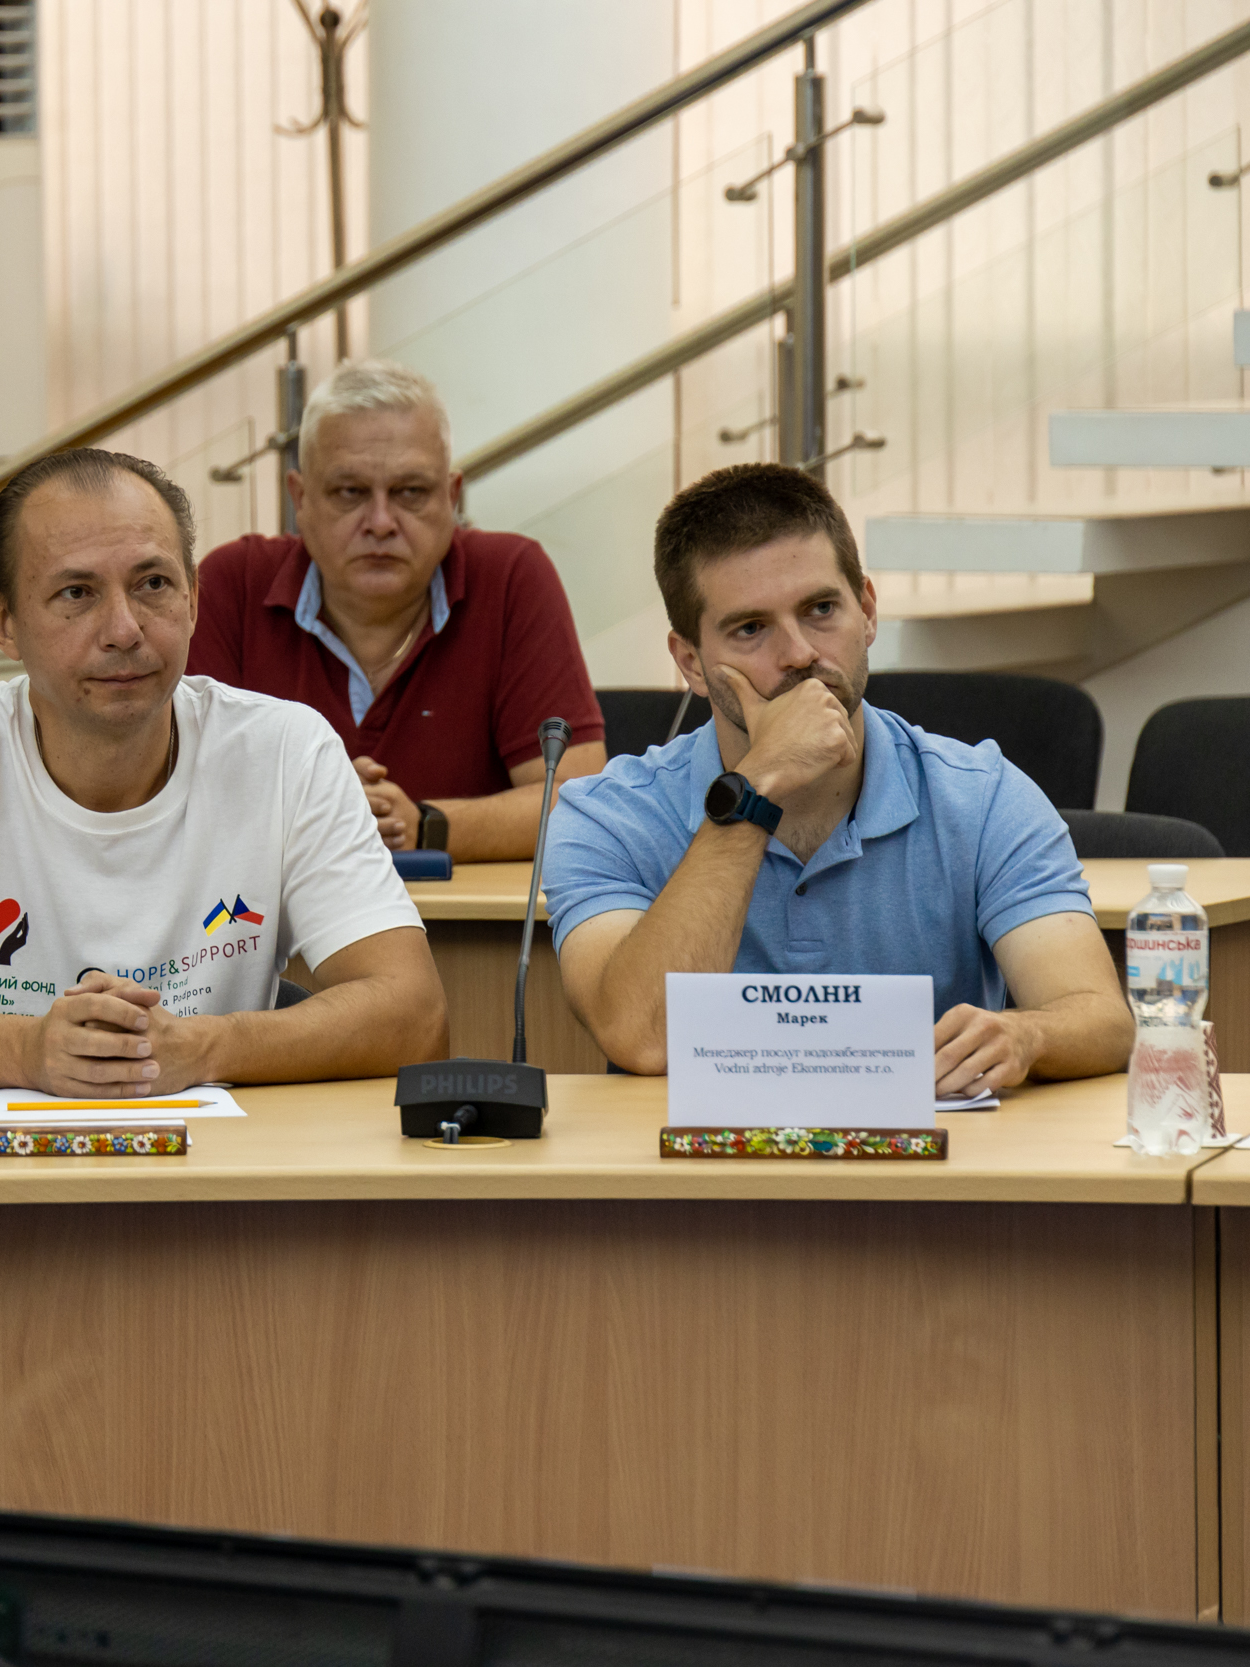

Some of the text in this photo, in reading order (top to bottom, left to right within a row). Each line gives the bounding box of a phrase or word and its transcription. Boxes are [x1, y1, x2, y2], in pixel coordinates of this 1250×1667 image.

[21, 980, 56, 996] ФОНД
[167, 976, 189, 991] fond
[173, 986, 212, 1004] podpora
[741, 985, 862, 1004] СМОЛНИ
[776, 1012, 829, 1027] Марек
[693, 1047, 758, 1060] Менеджер
[761, 1049, 801, 1061] послуг
[752, 1063, 788, 1076] zdroje
[791, 1063, 862, 1074] Ekomonitor
[865, 1065, 894, 1074] s.r.o.
[420, 1074, 518, 1095] PHILIPS
